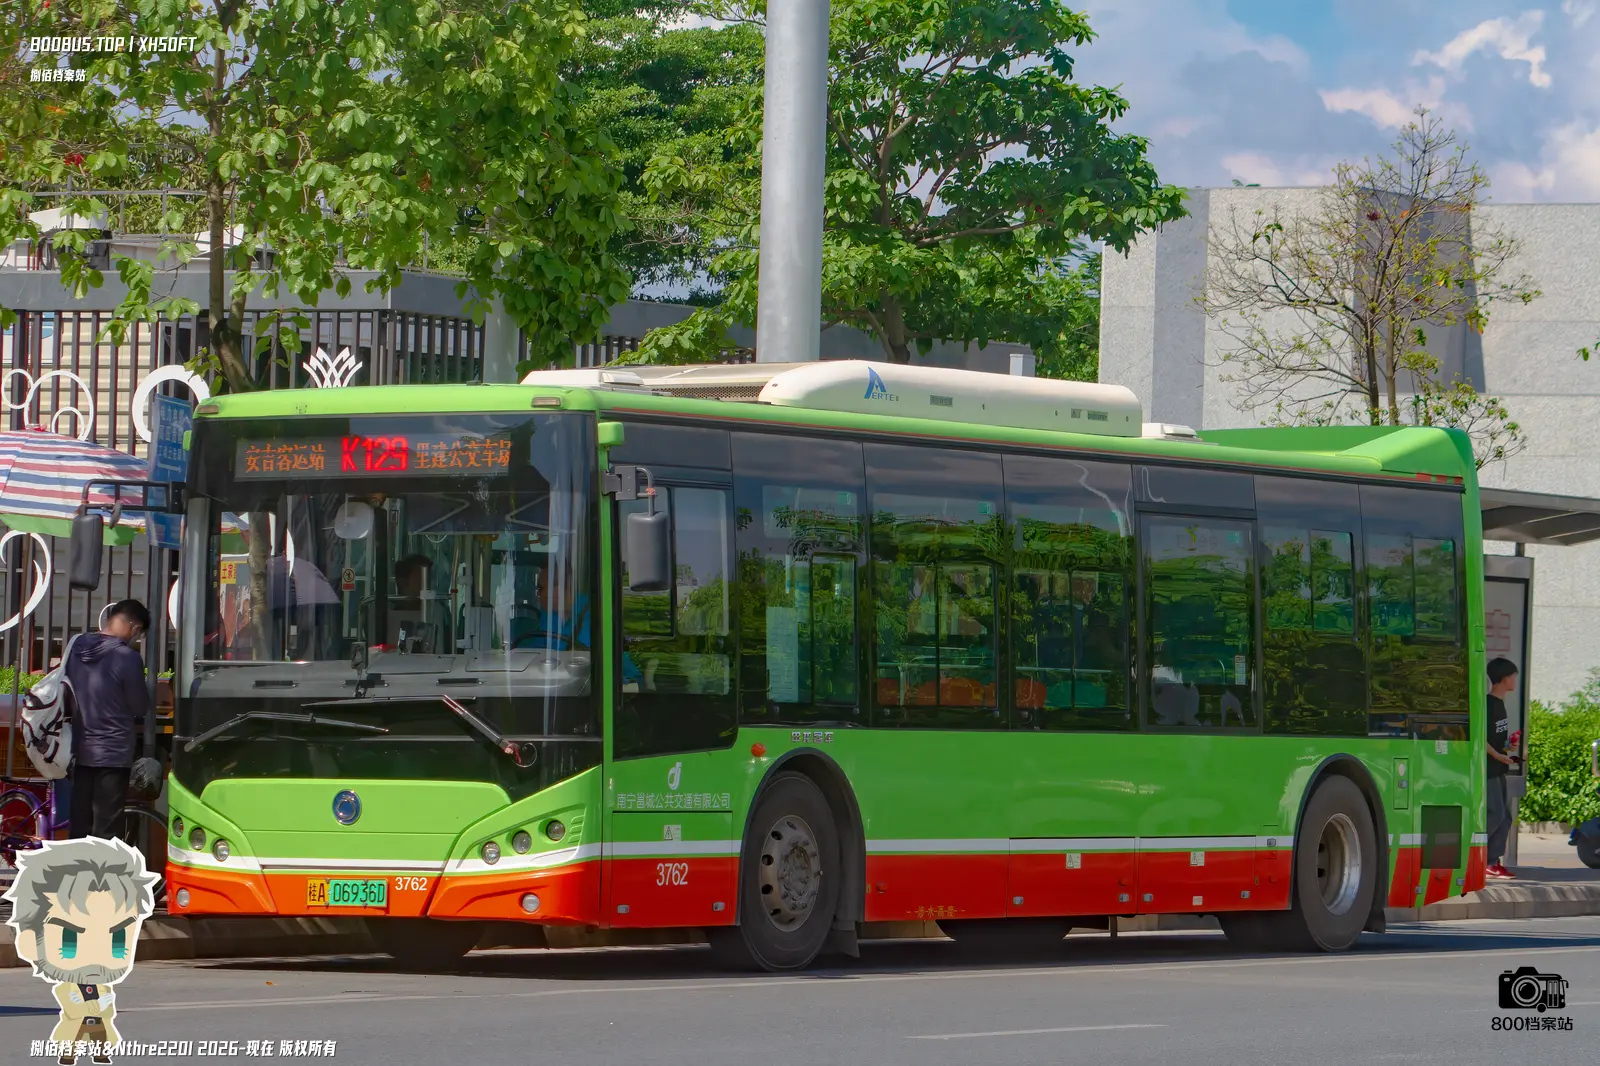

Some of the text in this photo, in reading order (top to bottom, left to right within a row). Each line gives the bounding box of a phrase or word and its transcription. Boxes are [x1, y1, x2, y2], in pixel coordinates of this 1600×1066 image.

[340, 436, 408, 472] K129
[394, 876, 428, 891] 3762
[656, 862, 689, 886] 3762
